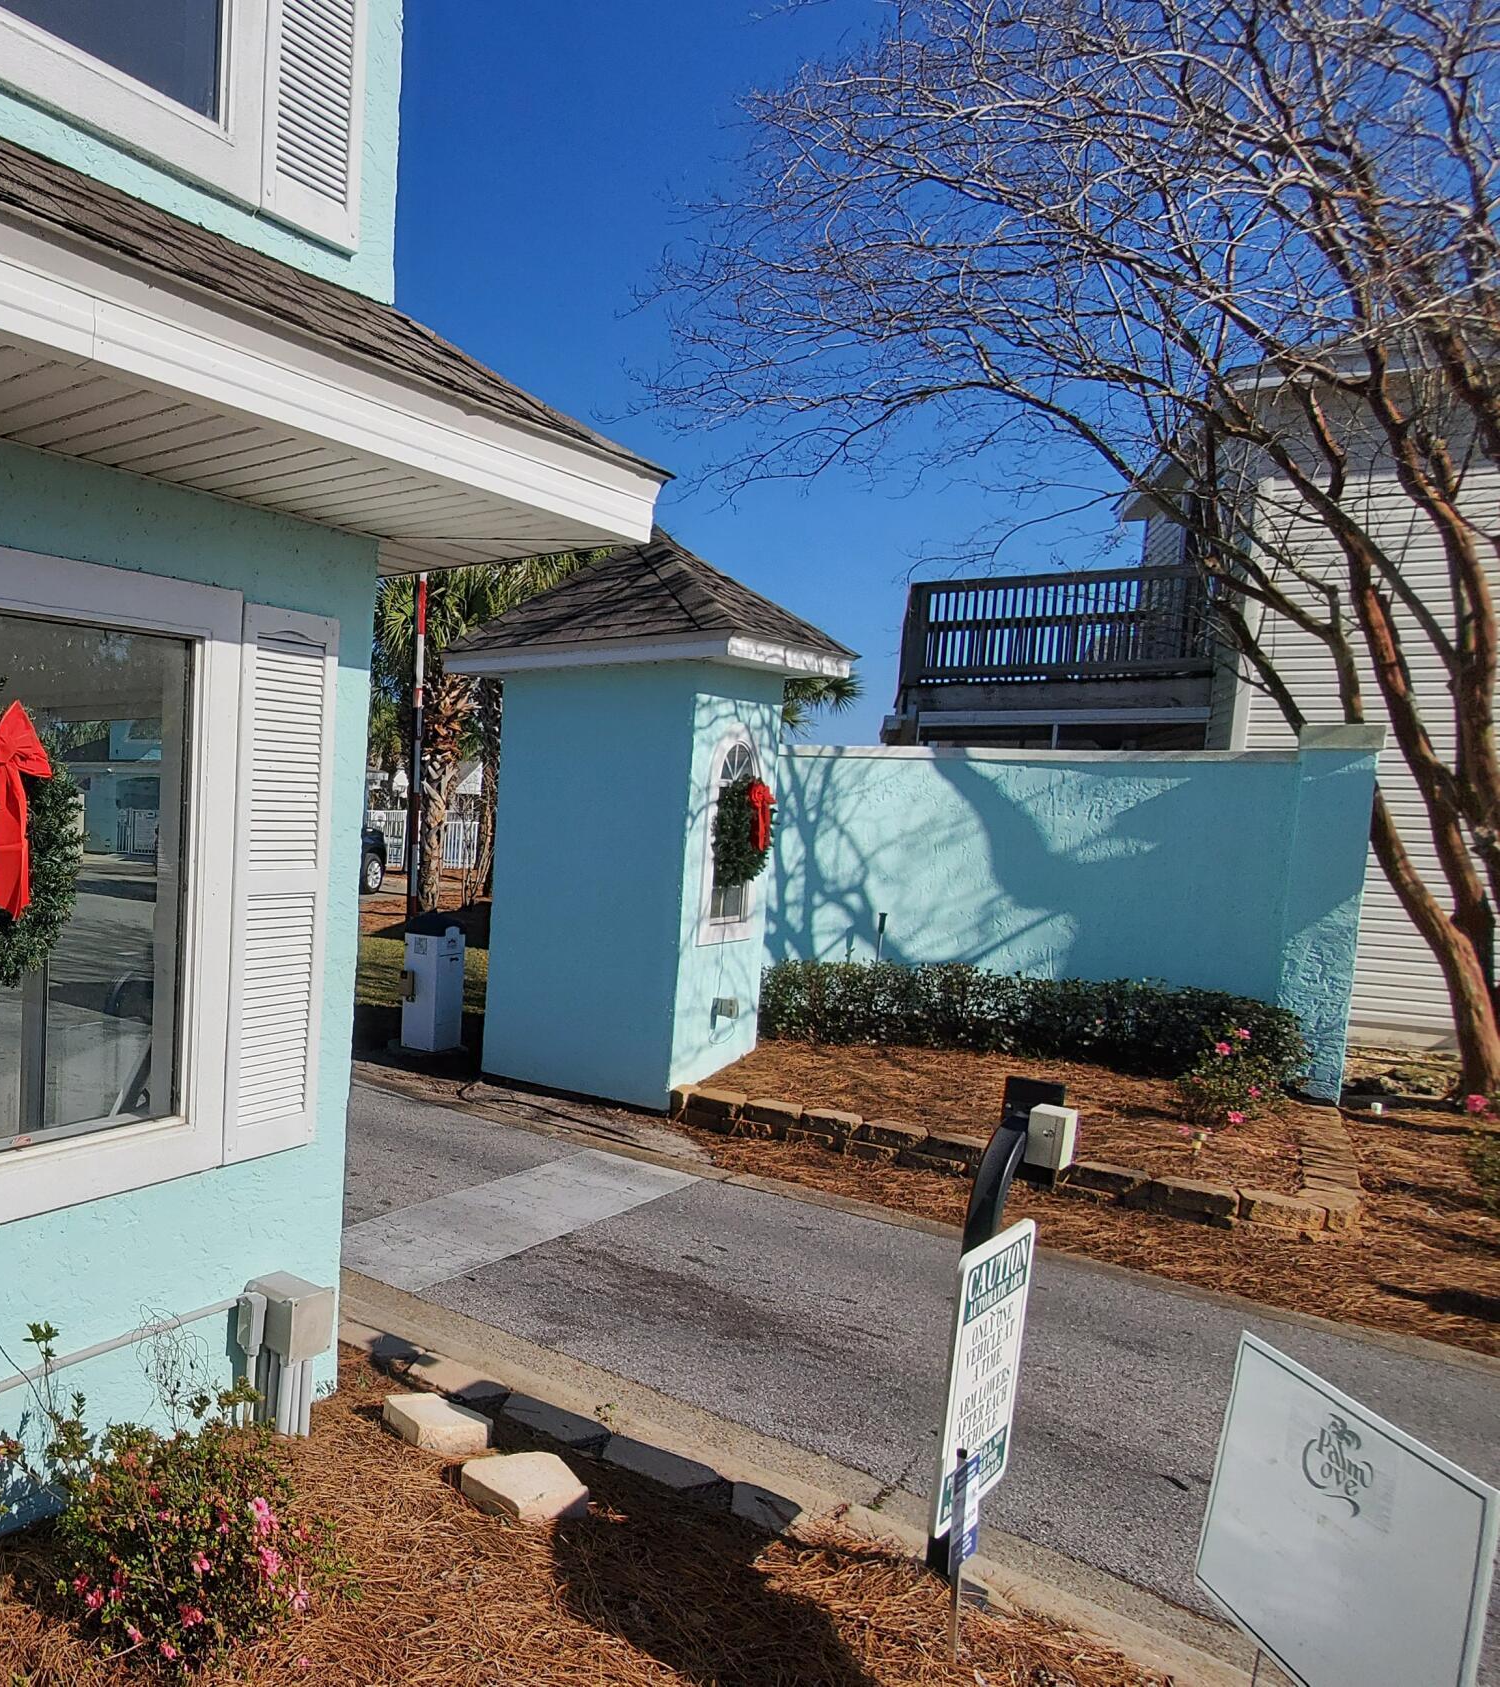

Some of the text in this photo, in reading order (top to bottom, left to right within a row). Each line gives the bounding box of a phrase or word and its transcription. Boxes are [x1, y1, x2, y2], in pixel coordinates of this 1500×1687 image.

[967, 1236, 1029, 1303] CAUTION
[967, 1280, 1008, 1321] AUTOMATIC
[971, 1300, 1013, 1346] ONLY ONE
[965, 1318, 1015, 1370] VEHICLE AT
[955, 1382, 1008, 1442] AFTER EACH
[957, 1363, 1010, 1421] ARM LOWERS
[1302, 1438, 1359, 1496] Cove
[1316, 1426, 1373, 1488] Palm
